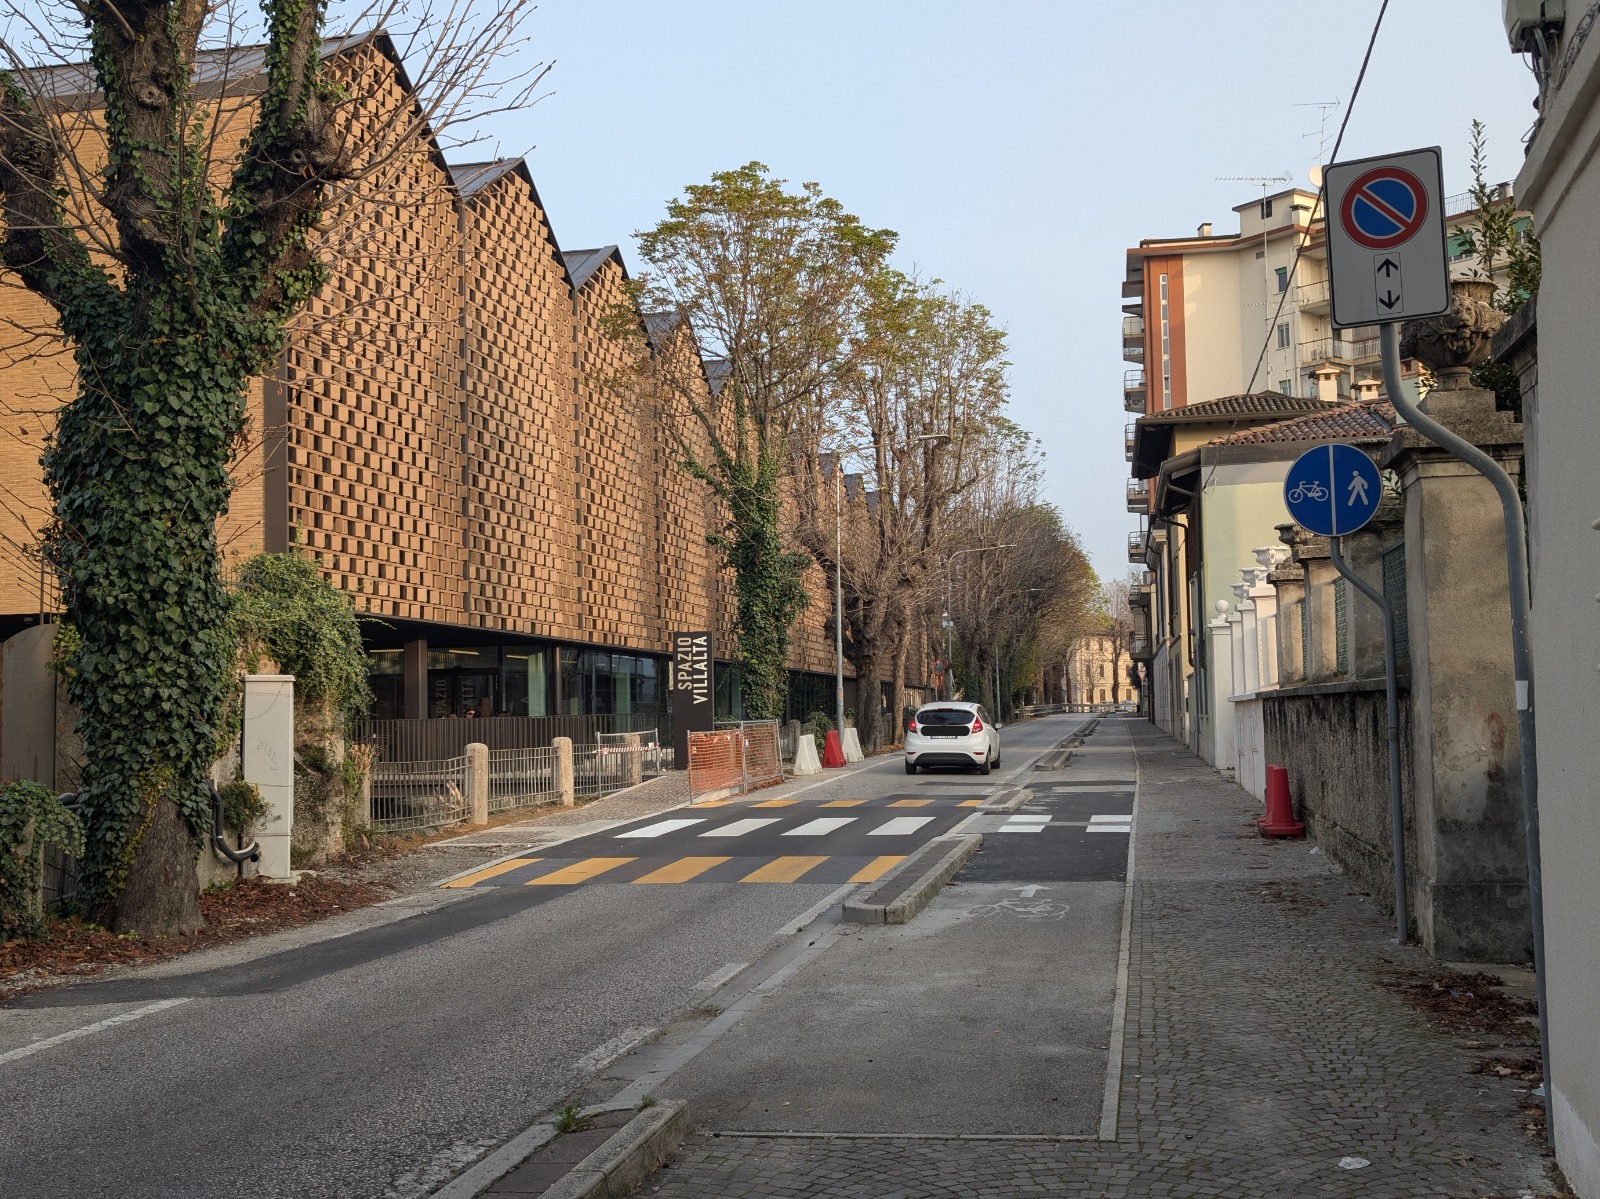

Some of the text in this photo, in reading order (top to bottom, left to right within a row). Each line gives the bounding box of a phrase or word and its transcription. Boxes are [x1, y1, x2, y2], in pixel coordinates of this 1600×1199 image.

[677, 637, 692, 690] SPAZIO
[692, 636, 708, 705] VILLALTA
[435, 679, 447, 714] PAZIO
